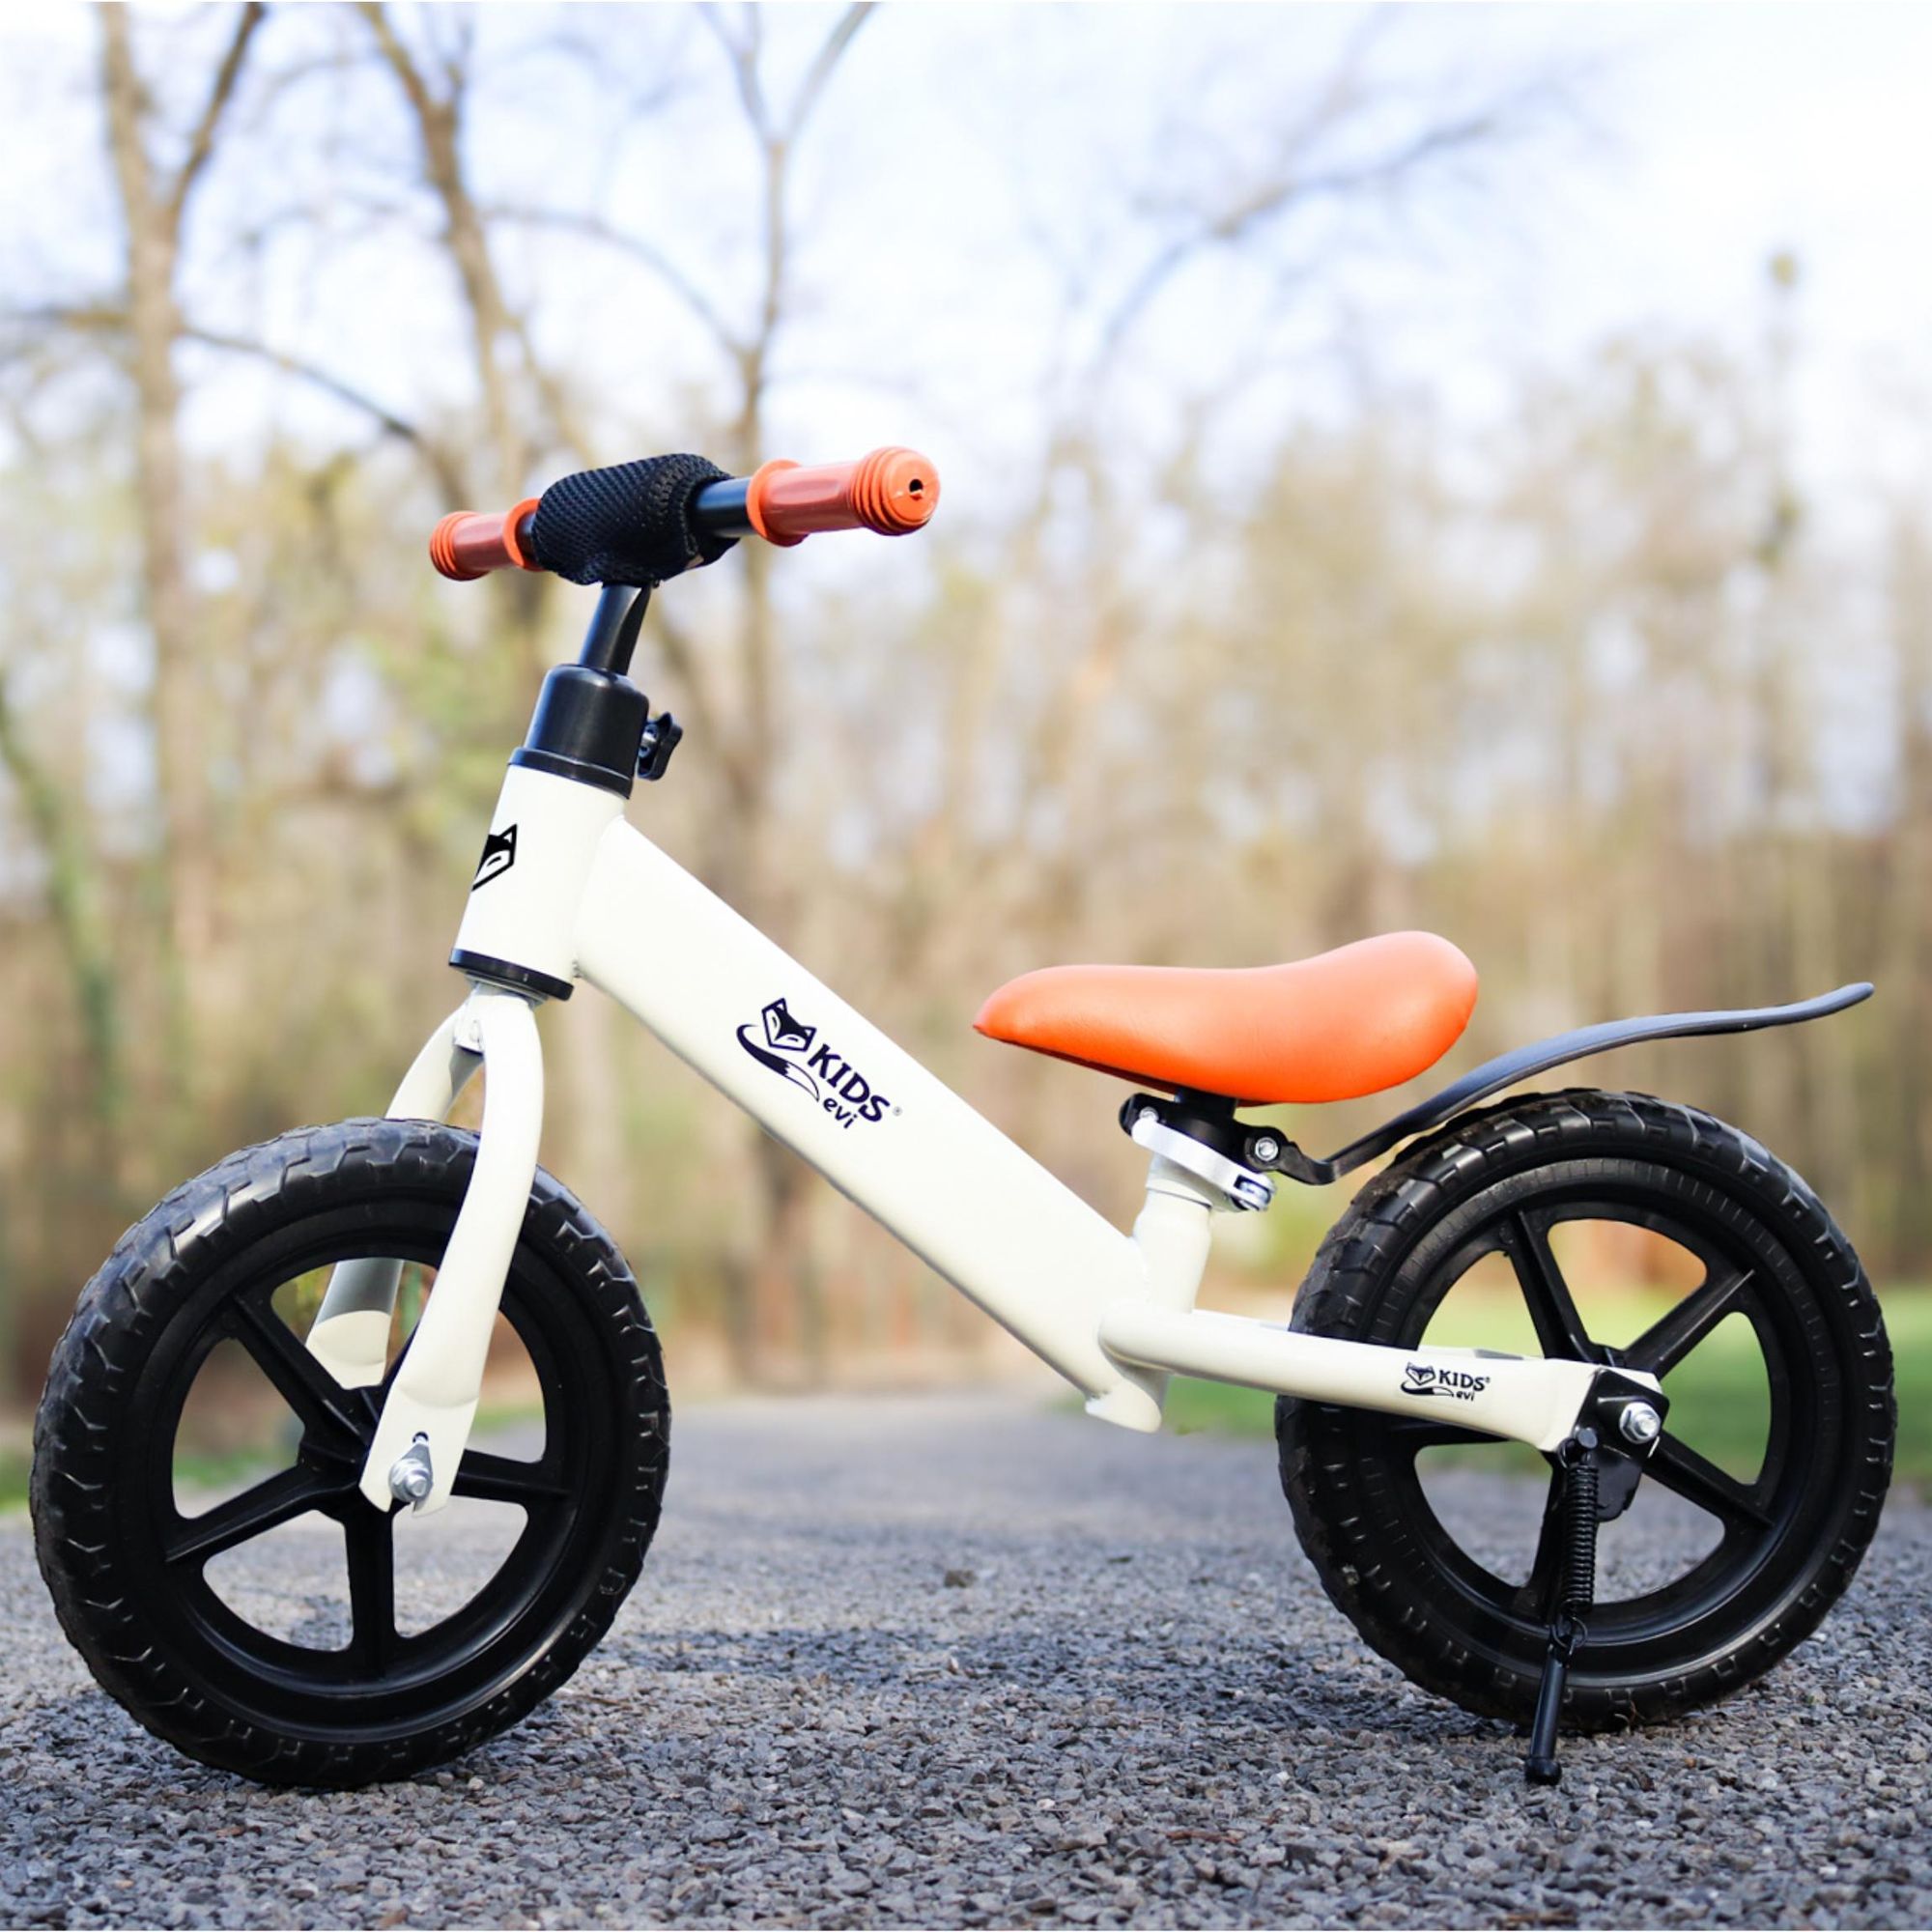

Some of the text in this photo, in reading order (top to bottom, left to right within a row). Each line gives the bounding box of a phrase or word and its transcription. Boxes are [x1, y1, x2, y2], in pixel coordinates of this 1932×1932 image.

[808, 1043, 891, 1122] KIDS
[823, 1097, 858, 1128] evi
[1438, 1369, 1485, 1391] KIDS
[1456, 1390, 1475, 1401] evi
